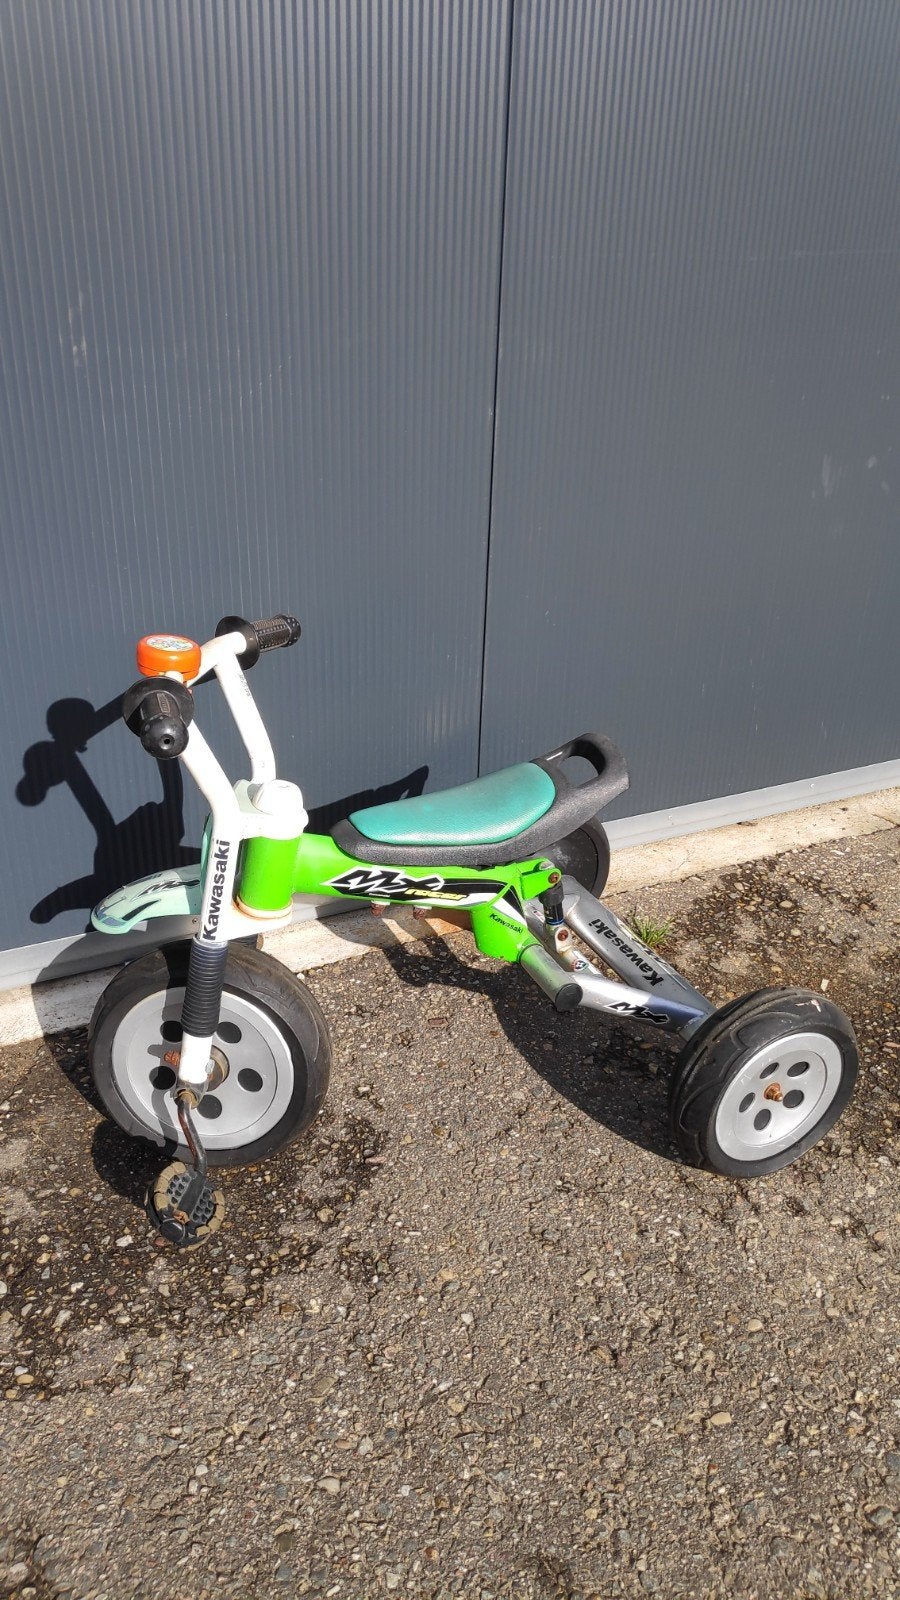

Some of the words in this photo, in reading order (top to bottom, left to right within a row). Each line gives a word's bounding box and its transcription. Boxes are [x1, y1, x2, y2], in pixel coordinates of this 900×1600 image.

[202, 840, 231, 941] Kawasaki
[489, 912, 524, 934] Kawasaki
[588, 918, 665, 987] Kawasaki
